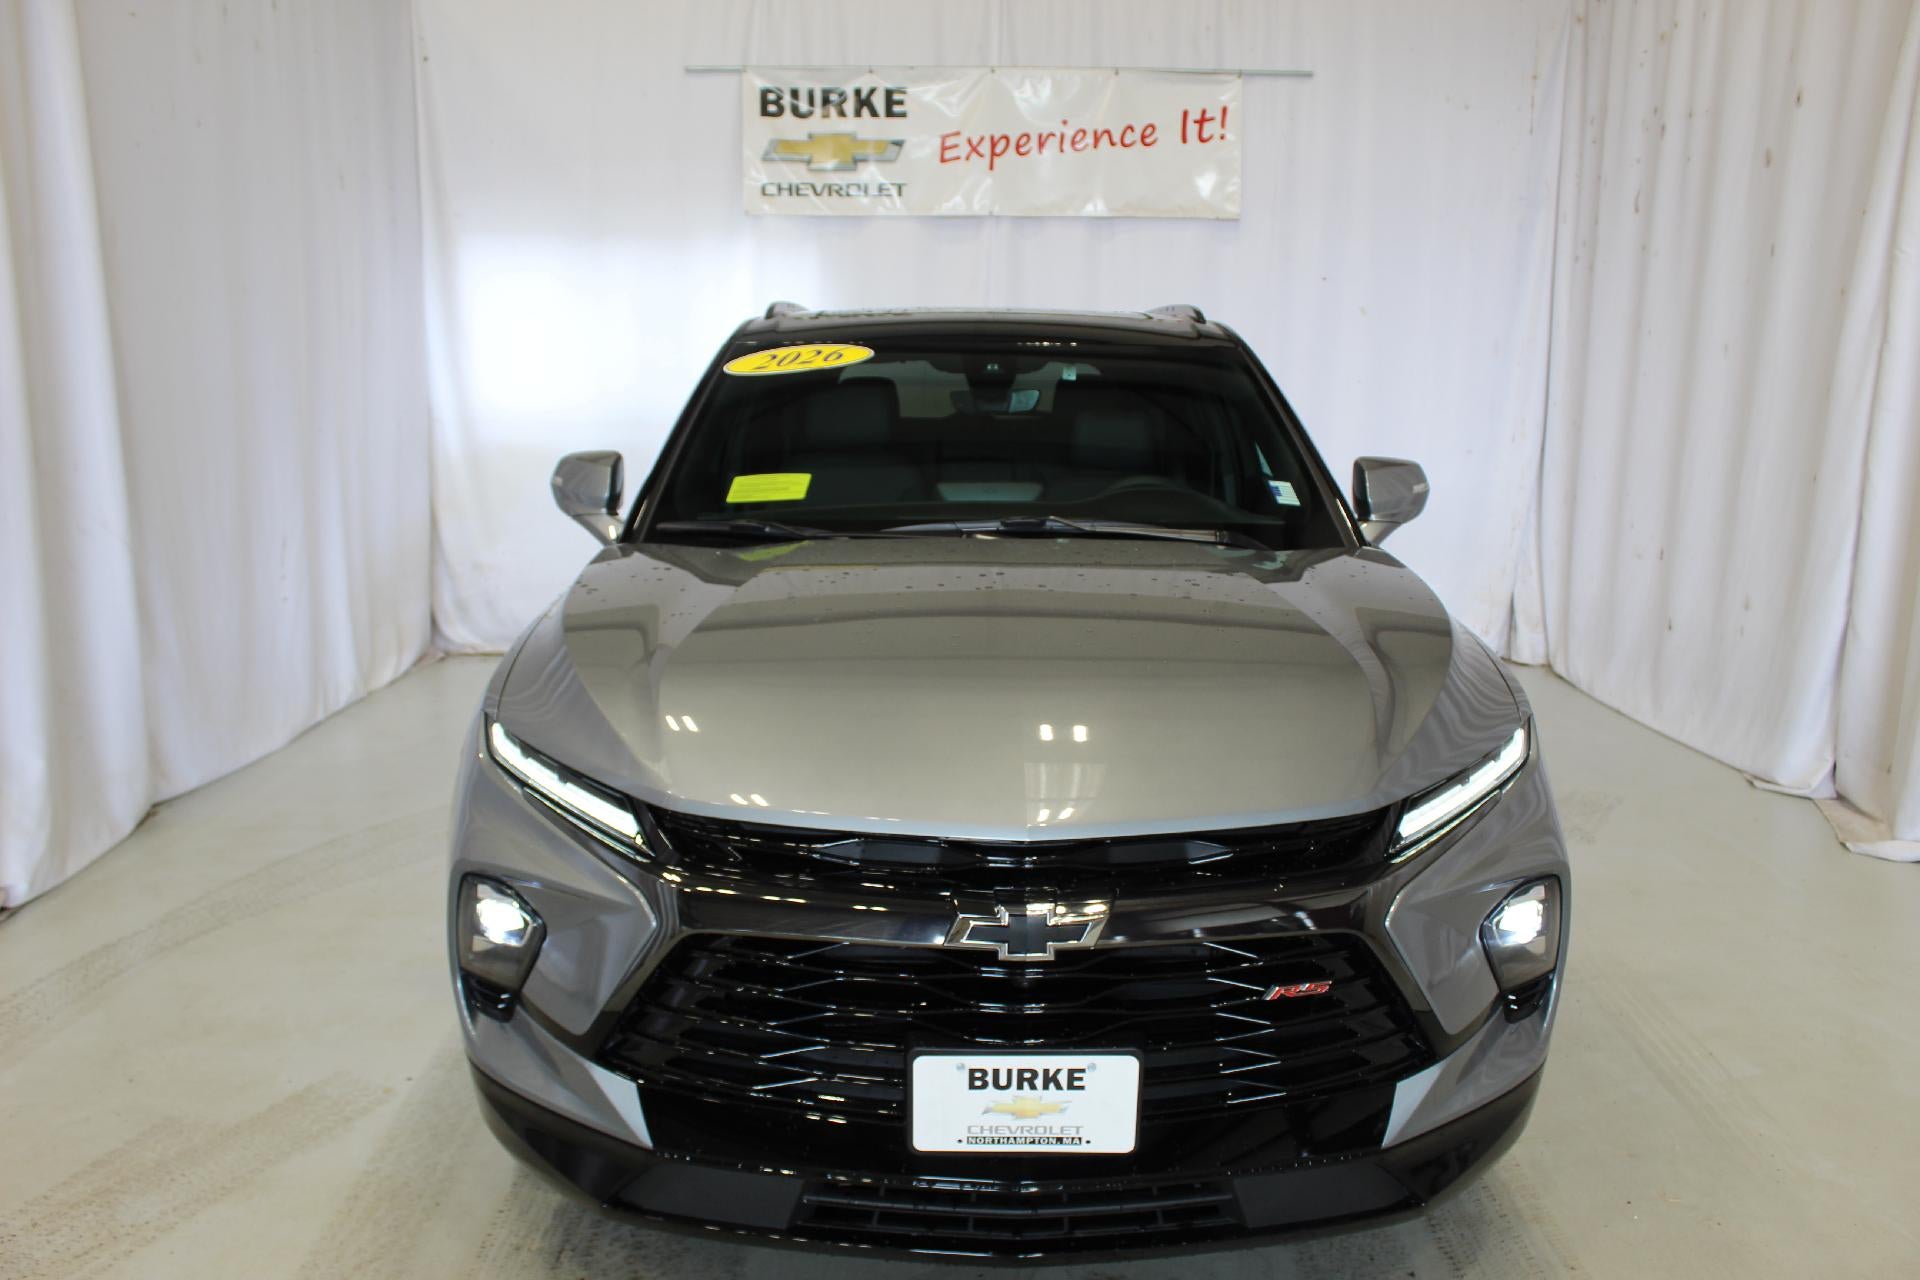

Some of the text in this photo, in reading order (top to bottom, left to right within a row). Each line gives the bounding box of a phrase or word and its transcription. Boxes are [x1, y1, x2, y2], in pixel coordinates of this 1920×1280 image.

[760, 87, 907, 118] BURKE
[939, 106, 1228, 170] Experience It!
[761, 182, 908, 198] CHEVROLET
[753, 349, 844, 370] 2026
[1262, 980, 1332, 1001] RS
[968, 1068, 1086, 1091] BURKE
[967, 1125, 1084, 1136] CHEVROLET
